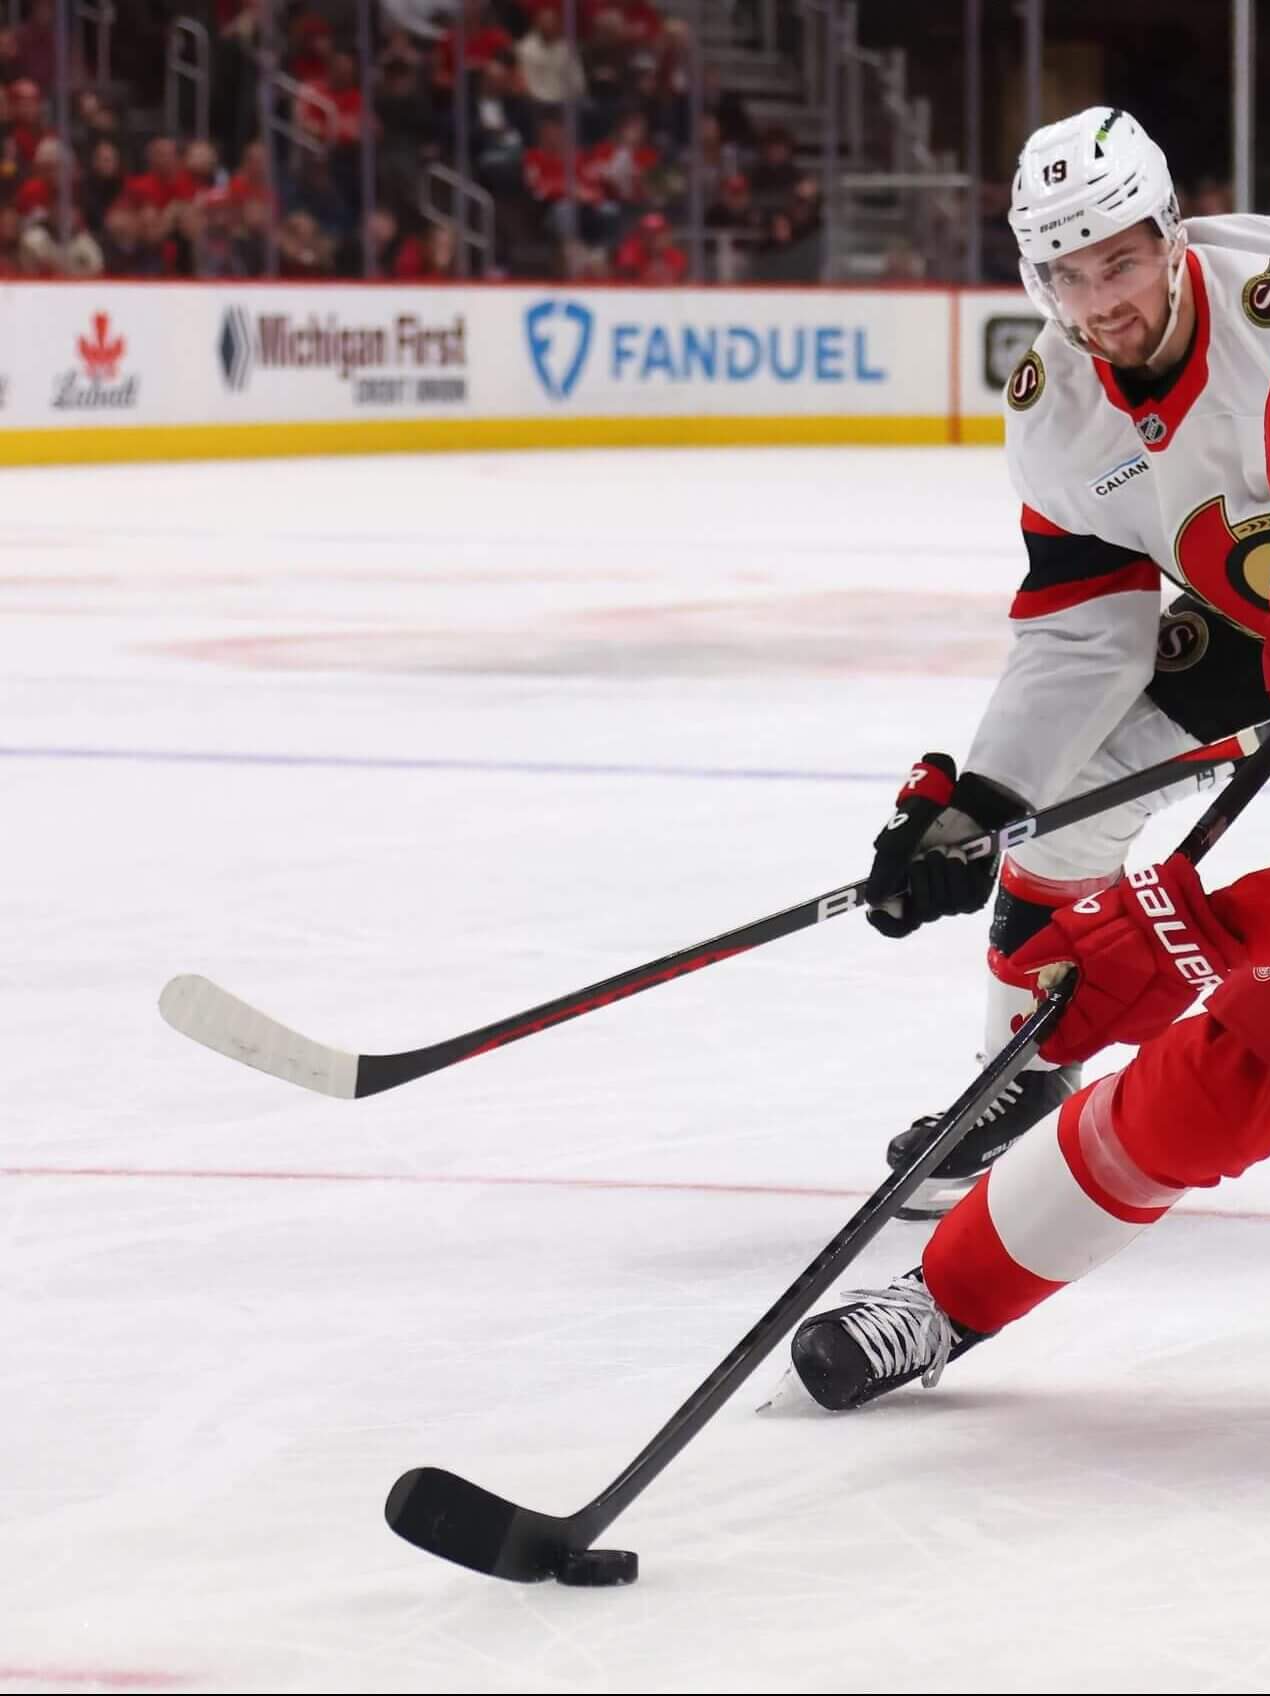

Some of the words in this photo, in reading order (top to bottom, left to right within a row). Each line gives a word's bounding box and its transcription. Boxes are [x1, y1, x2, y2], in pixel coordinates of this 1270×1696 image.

[1042, 159, 1068, 187] 19
[1039, 209, 1085, 234] BAUER
[257, 312, 386, 381] Michigan
[394, 312, 467, 367] First
[610, 324, 887, 382] FANDUEL
[1095, 461, 1150, 496] CALIAN
[1128, 866, 1225, 992] BAUER
[981, 1137, 1018, 1162] BAU
